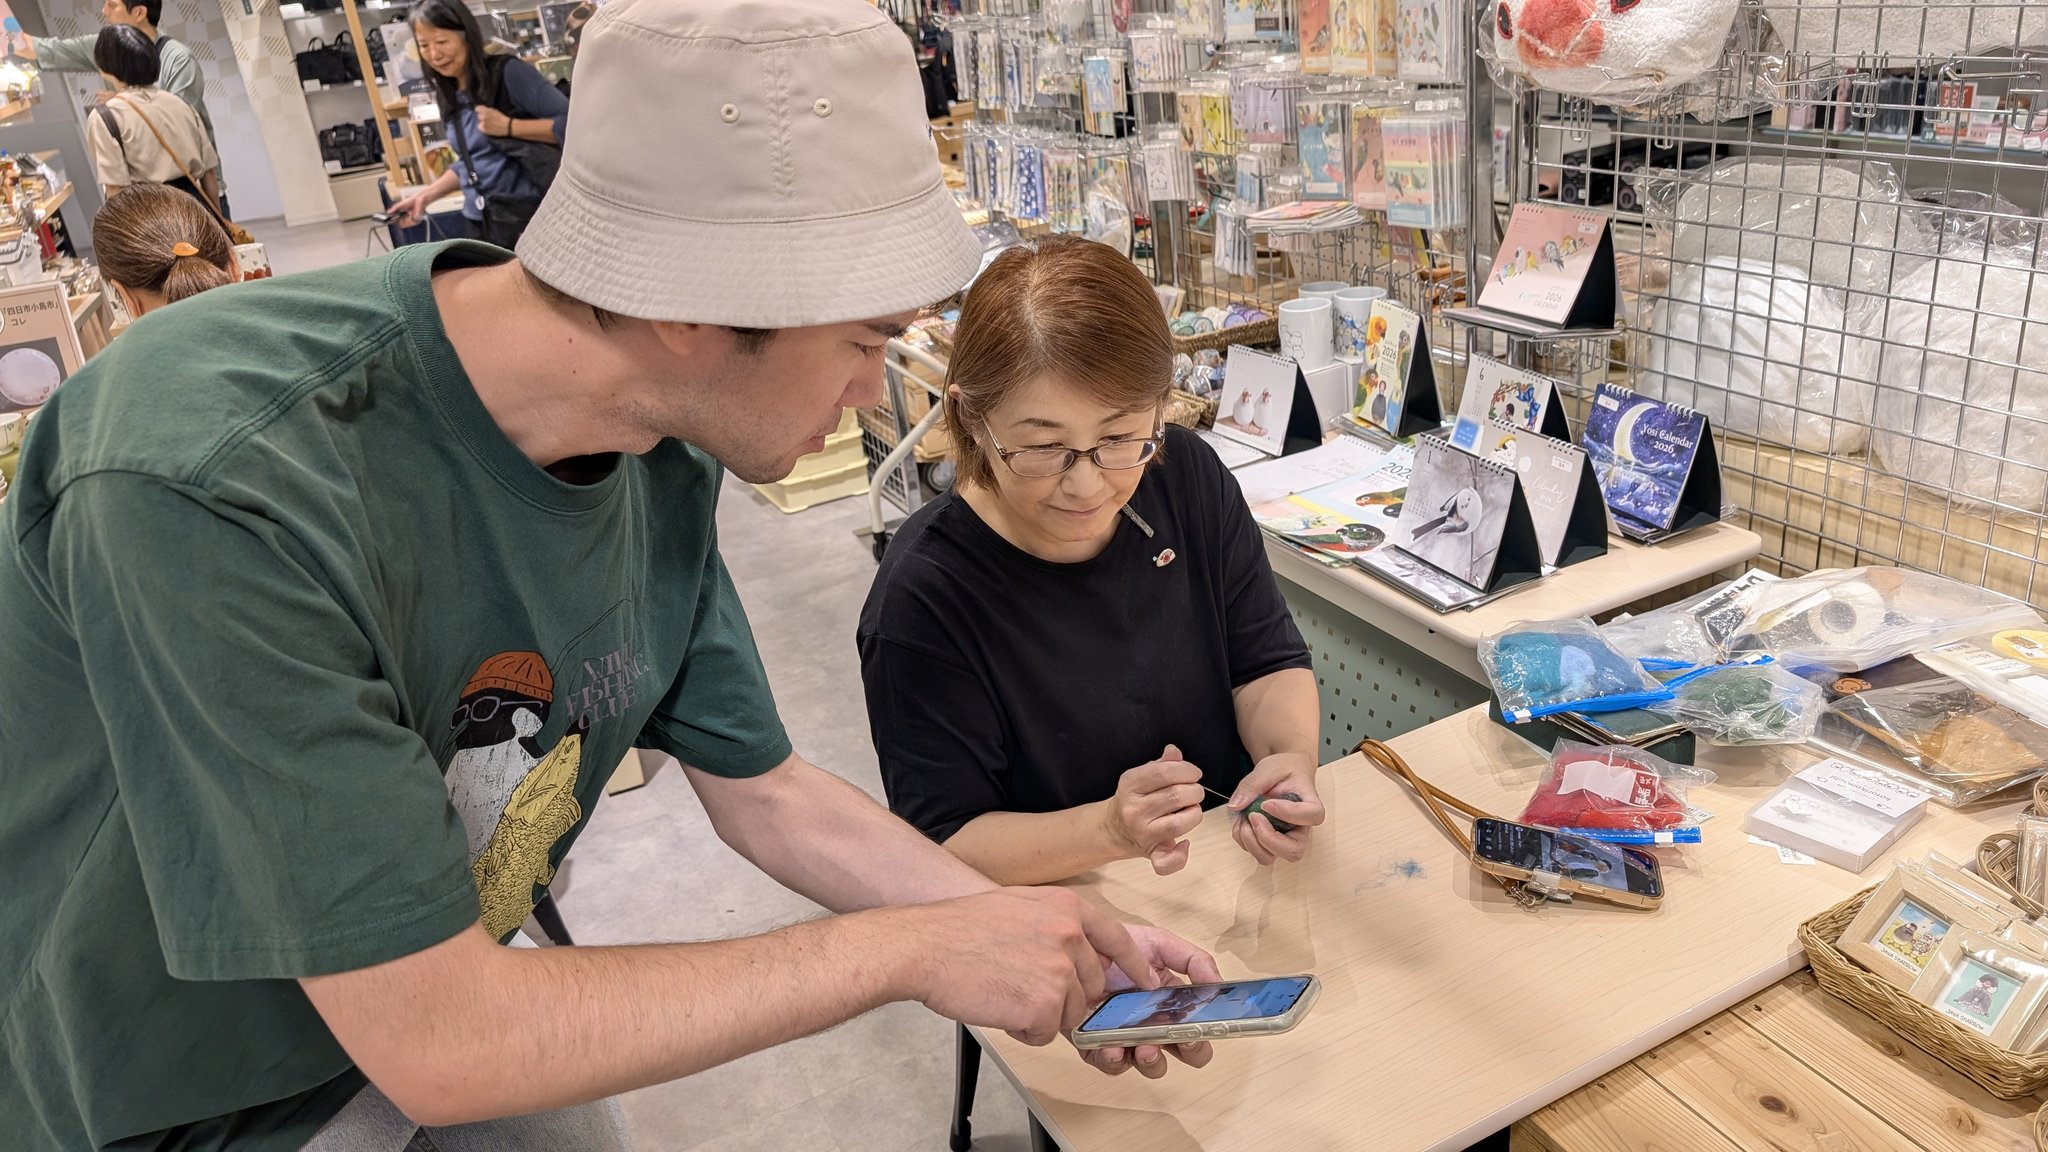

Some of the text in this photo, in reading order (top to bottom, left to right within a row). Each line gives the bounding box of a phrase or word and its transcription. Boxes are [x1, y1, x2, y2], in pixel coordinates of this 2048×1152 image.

[1479, 367, 1485, 380] 6
[1643, 423, 1694, 449] Yosi Calendar
[1653, 441, 1675, 454] 2026
[565, 652, 650, 717] FISHING
[578, 686, 637, 730] CLUB
[1639, 776, 1653, 785] メモ
[1880, 947, 1894, 958] JAVA
[1945, 1008, 1960, 1019] JAVA
